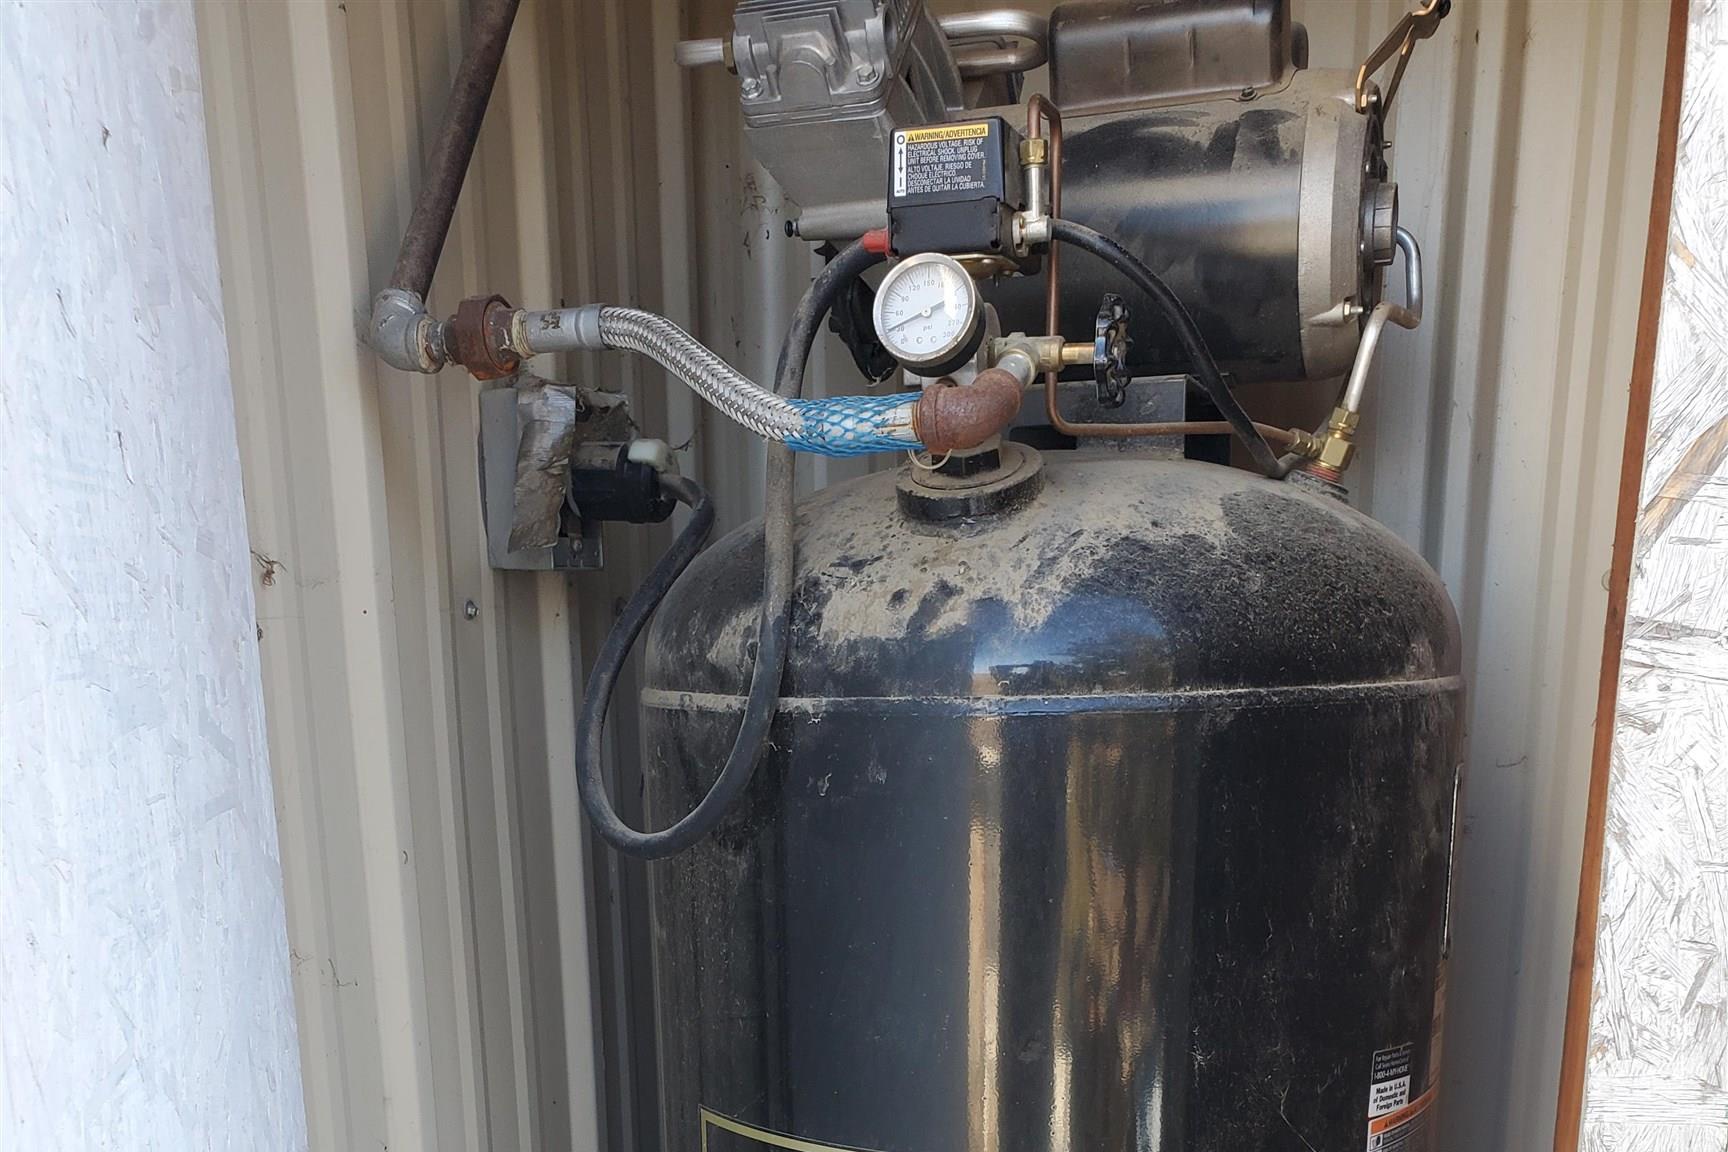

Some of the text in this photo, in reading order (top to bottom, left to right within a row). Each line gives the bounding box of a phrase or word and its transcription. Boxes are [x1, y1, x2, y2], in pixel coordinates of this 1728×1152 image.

[915, 127, 986, 140] WARNING/ADVERTENCIA
[907, 142, 937, 150] HAZARDOUS
[907, 149, 936, 158] ELECTRICAL
[907, 157, 919, 165] UNIT
[920, 156, 939, 164] BEFORE
[940, 154, 966, 162] REMOVING
[908, 165, 920, 173] ALTO
[945, 162, 963, 170] RIESGO
[908, 172, 928, 180] CHOQUE
[908, 178, 942, 187] DESCONECTAR
[932, 184, 950, 192] QUITAR
[1376, 1086, 1388, 1094] Made
[1380, 1092, 1398, 1102] Domestic
[1376, 1102, 1392, 1111] Foreign
